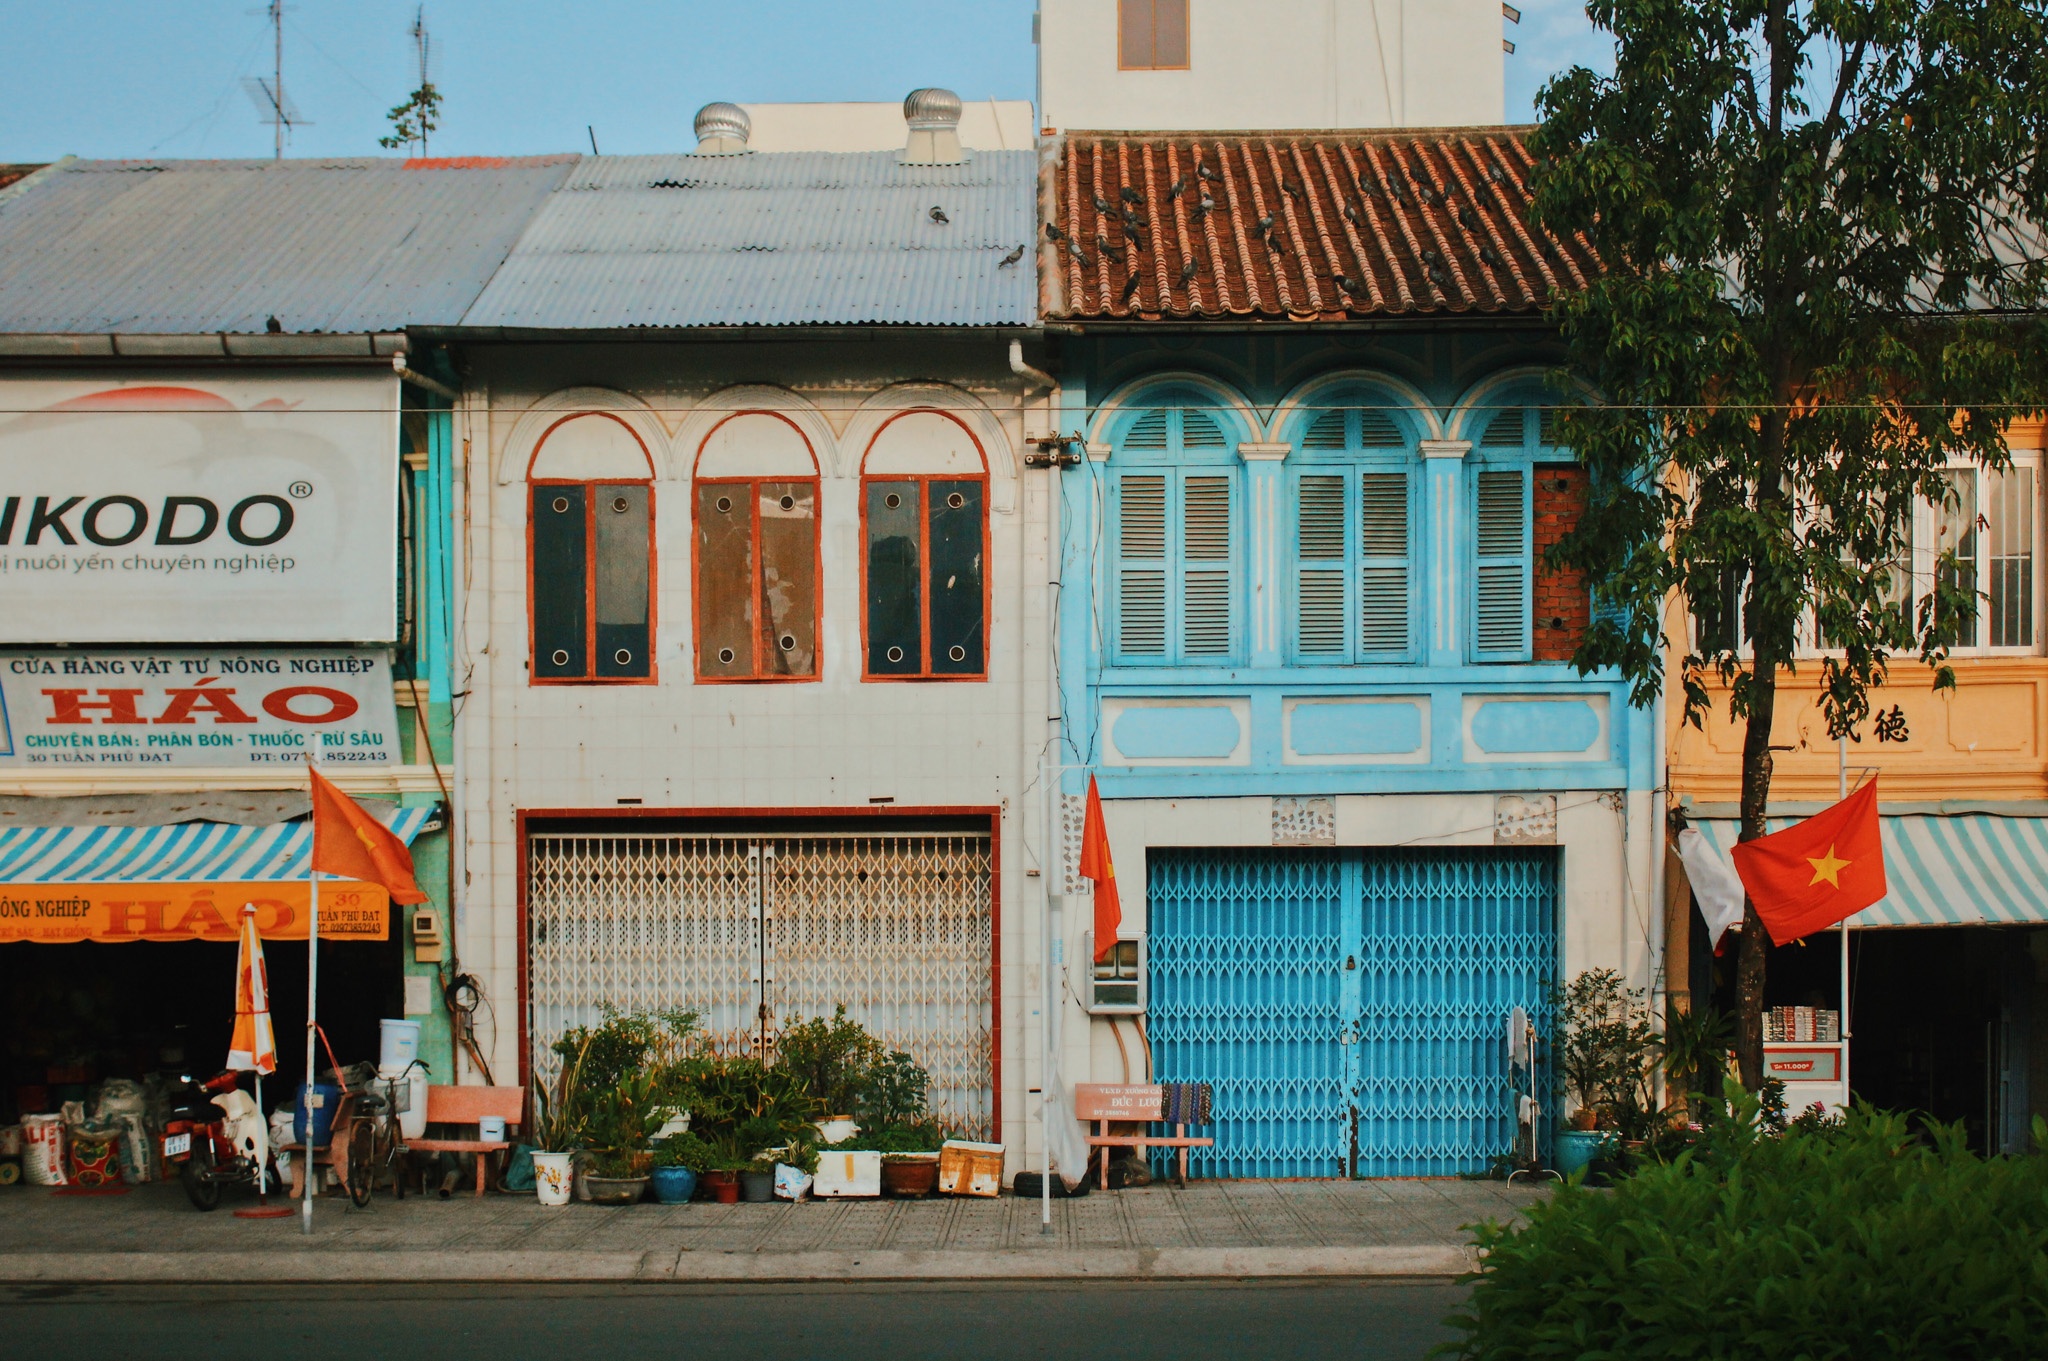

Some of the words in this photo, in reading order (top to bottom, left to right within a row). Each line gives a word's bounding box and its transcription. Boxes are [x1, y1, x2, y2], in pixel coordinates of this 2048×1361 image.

[16, 554, 66, 570] nuôi
[73, 552, 114, 574] yến
[122, 554, 206, 575] chuyên
[214, 554, 295, 574] nghiệp
[10, 655, 56, 674] CỬA
[62, 656, 125, 674] HÀNG
[130, 656, 173, 677] VẬT
[180, 658, 210, 674] TƯ
[220, 656, 280, 674] NÔNG
[290, 655, 374, 676] NGHIỆP
[41, 677, 359, 724] HÁO
[25, 732, 94, 747] CHUYÊN
[99, 731, 140, 747] BÁN:
[147, 732, 192, 747] PHÂN
[198, 731, 233, 746] BÓN
[249, 729, 304, 746] THUỐC
[351, 730, 383, 746] SÂU
[27, 753, 47, 762] 30
[140, 753, 173, 764] ĐẠT
[335, 894, 361, 906] 30
[36, 895, 91, 921] NGHIỆP
[101, 889, 295, 935] HÁO
